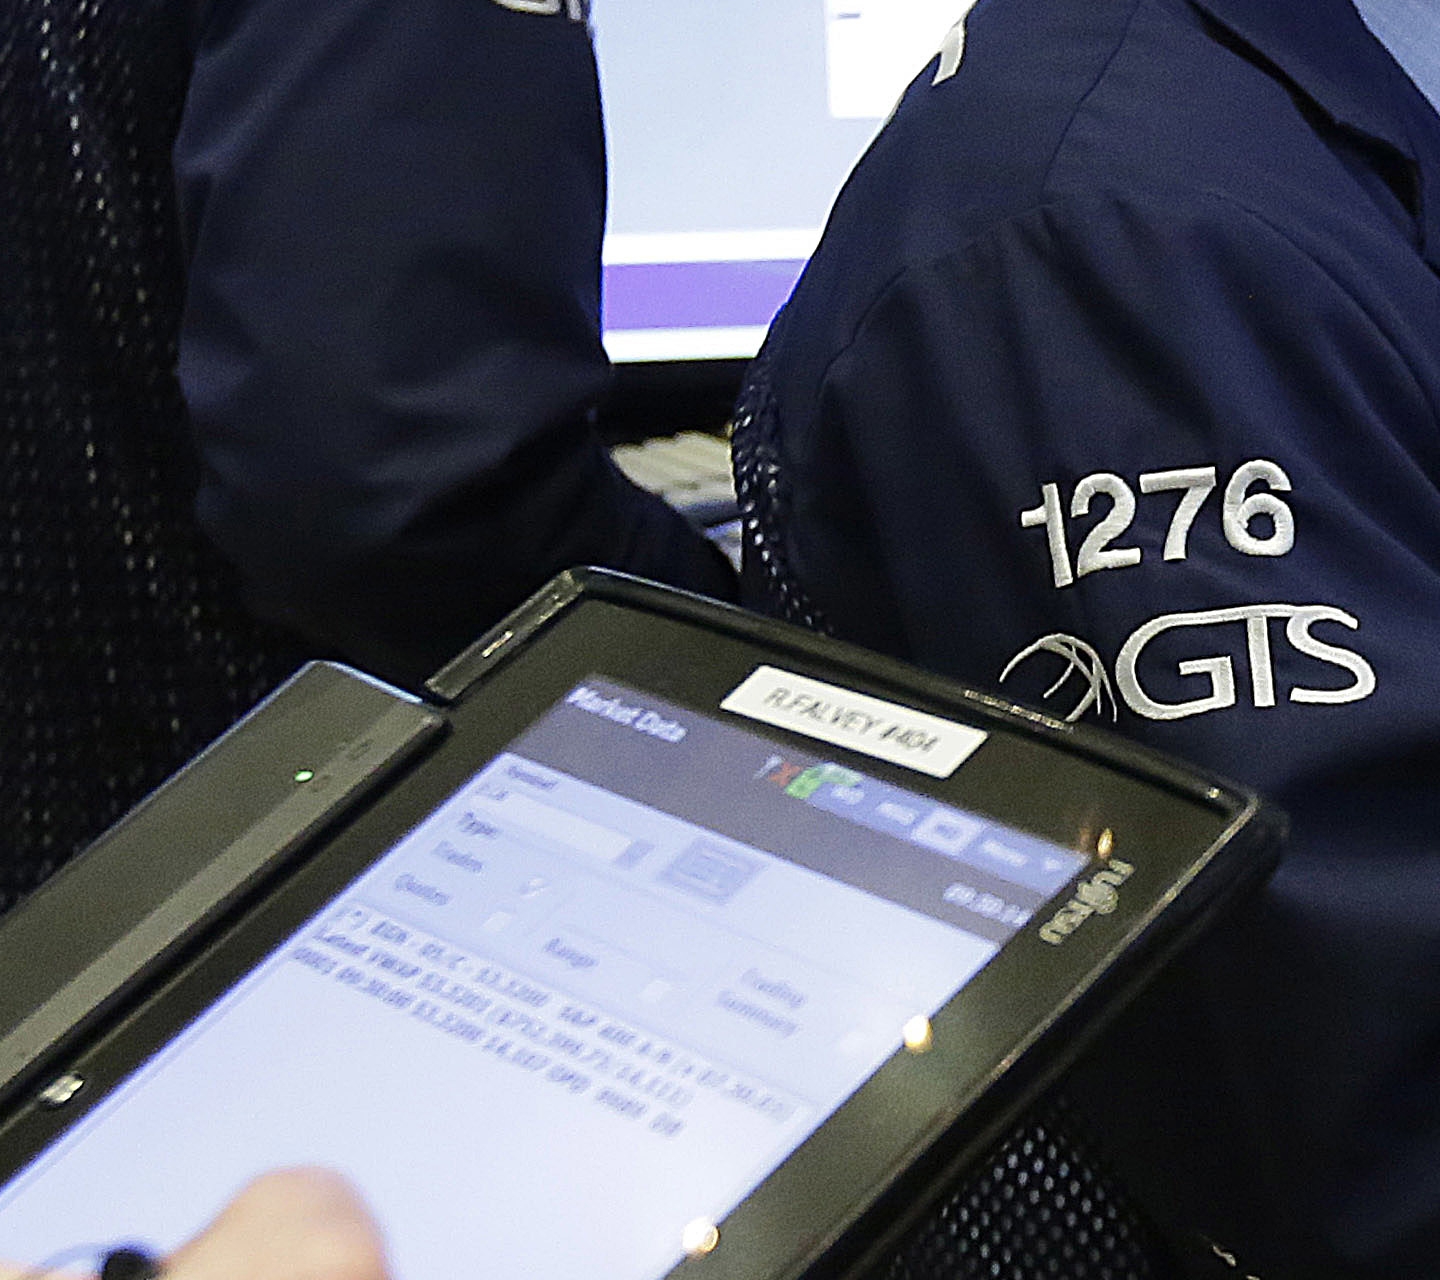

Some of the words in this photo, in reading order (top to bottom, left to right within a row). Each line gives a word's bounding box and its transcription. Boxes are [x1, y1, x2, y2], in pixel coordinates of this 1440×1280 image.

[1021, 459, 1296, 586] 1276
[565, 686, 643, 726] Market
[633, 709, 689, 744] Data
[1116, 604, 1376, 719] GTS
